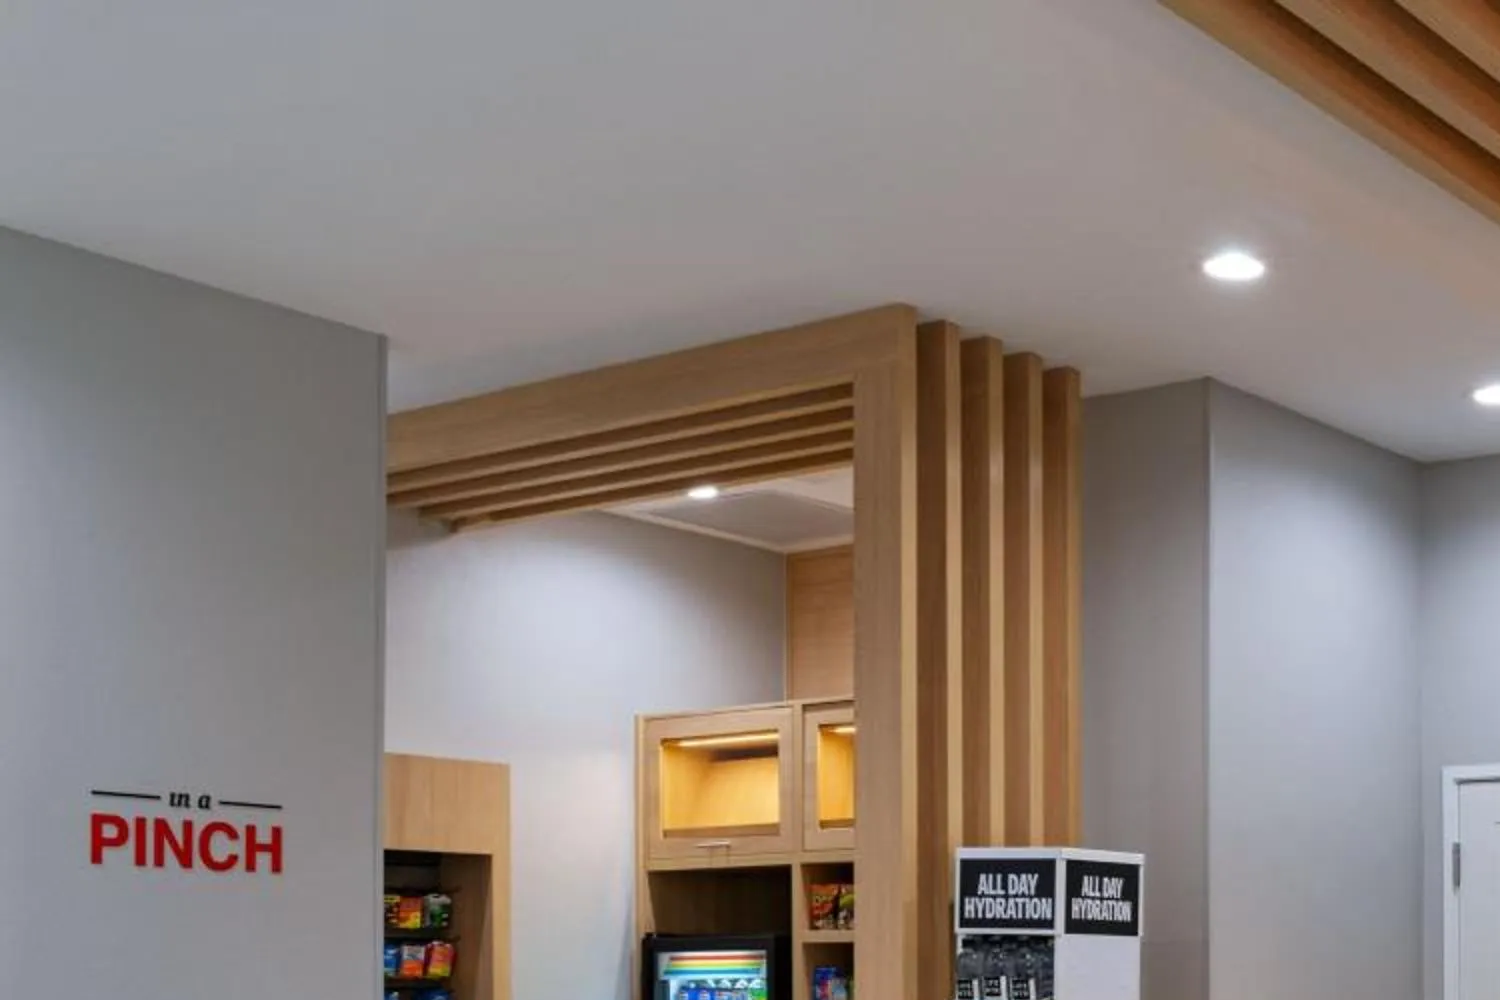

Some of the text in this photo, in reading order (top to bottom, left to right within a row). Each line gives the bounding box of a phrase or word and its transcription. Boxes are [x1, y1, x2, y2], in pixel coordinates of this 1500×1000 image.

[169, 791, 212, 810] in a
[90, 813, 283, 874] PINCH
[977, 873, 1039, 895] ALL DAY
[1081, 875, 1124, 899] ALL DAY
[964, 898, 1053, 920] HYDRATION
[1071, 898, 1132, 922] HYDRATION
